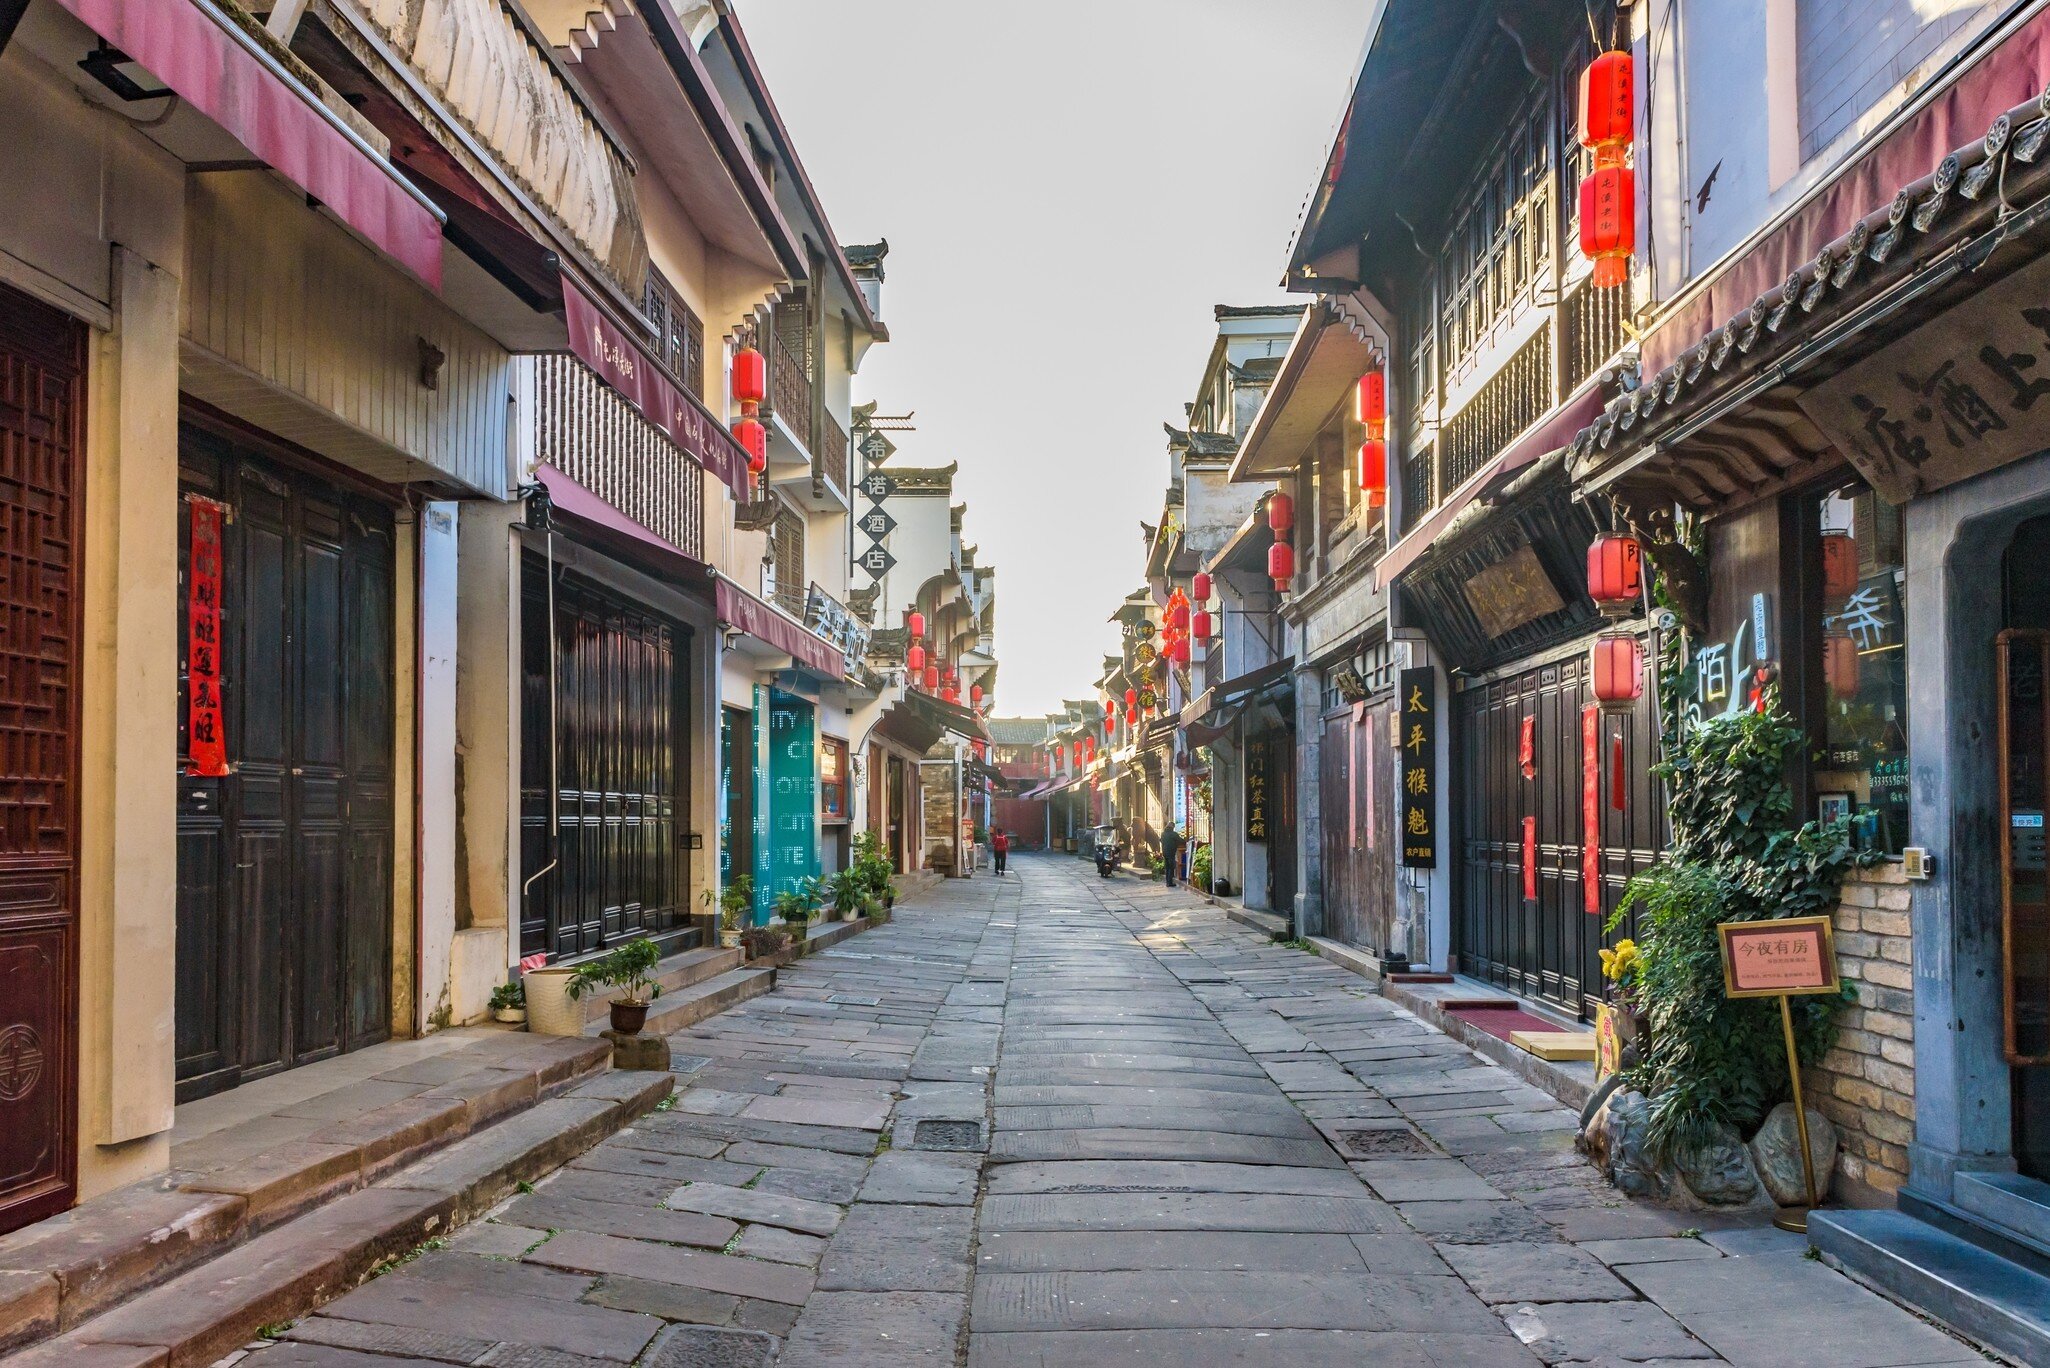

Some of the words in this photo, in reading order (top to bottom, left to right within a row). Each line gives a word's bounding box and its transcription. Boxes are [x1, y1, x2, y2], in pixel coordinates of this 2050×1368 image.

[1616, 63, 1631, 118] 屯溪老街
[1600, 178, 1615, 231] 屯溪老街
[866, 439, 887, 569] 希诺酒店
[1406, 685, 1429, 835] 太平猴魁
[1405, 847, 1432, 858] 农户直销
[1738, 939, 1809, 957] 今夜有房
